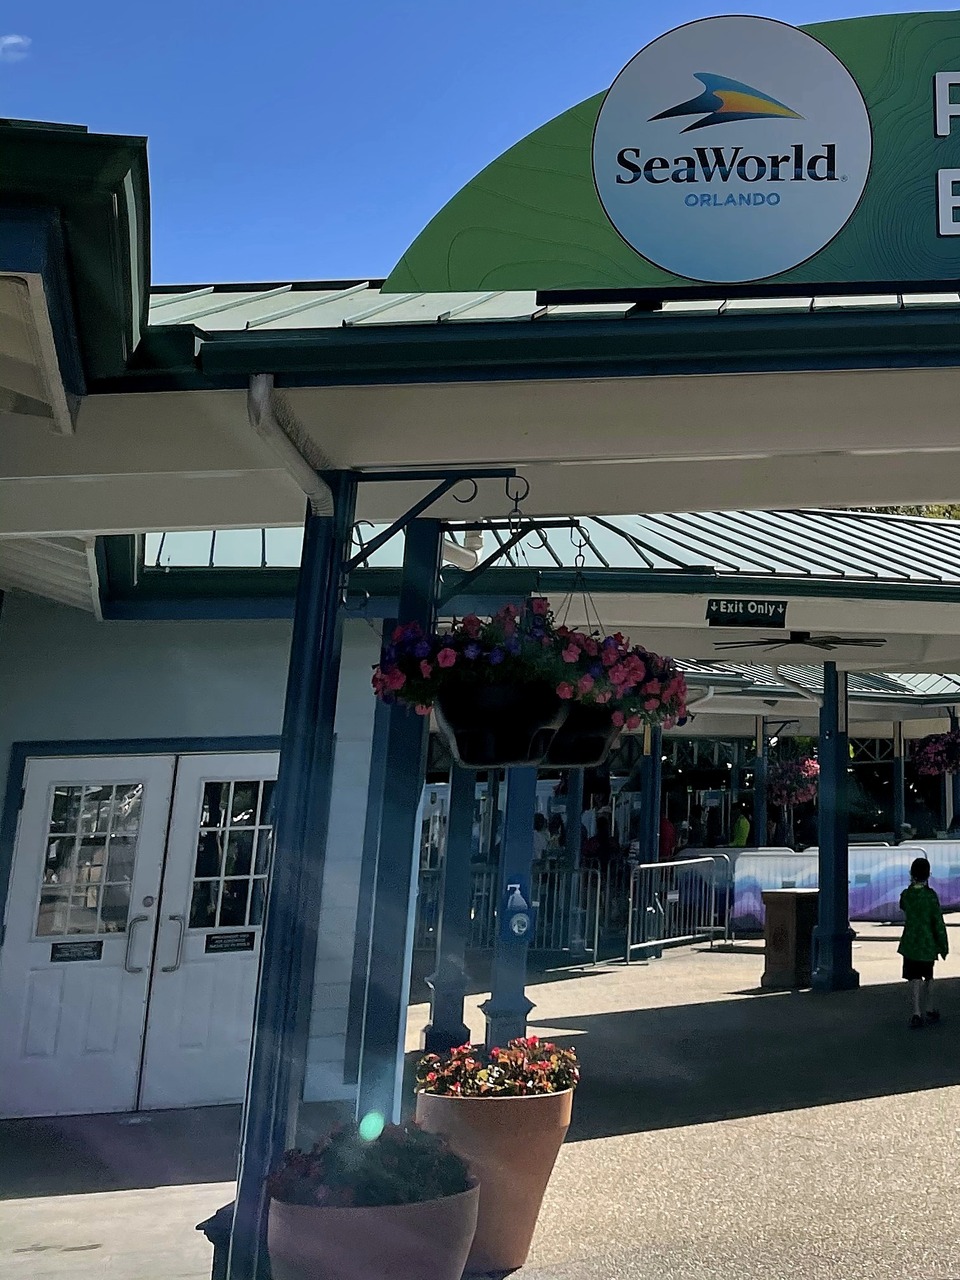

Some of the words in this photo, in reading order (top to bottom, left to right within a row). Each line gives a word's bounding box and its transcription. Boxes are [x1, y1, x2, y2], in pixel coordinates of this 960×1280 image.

[615, 143, 840, 185] SeaWorld
[684, 192, 781, 207] ORLANDO
[720, 601, 744, 613] Exit
[747, 601, 776, 616] Only
